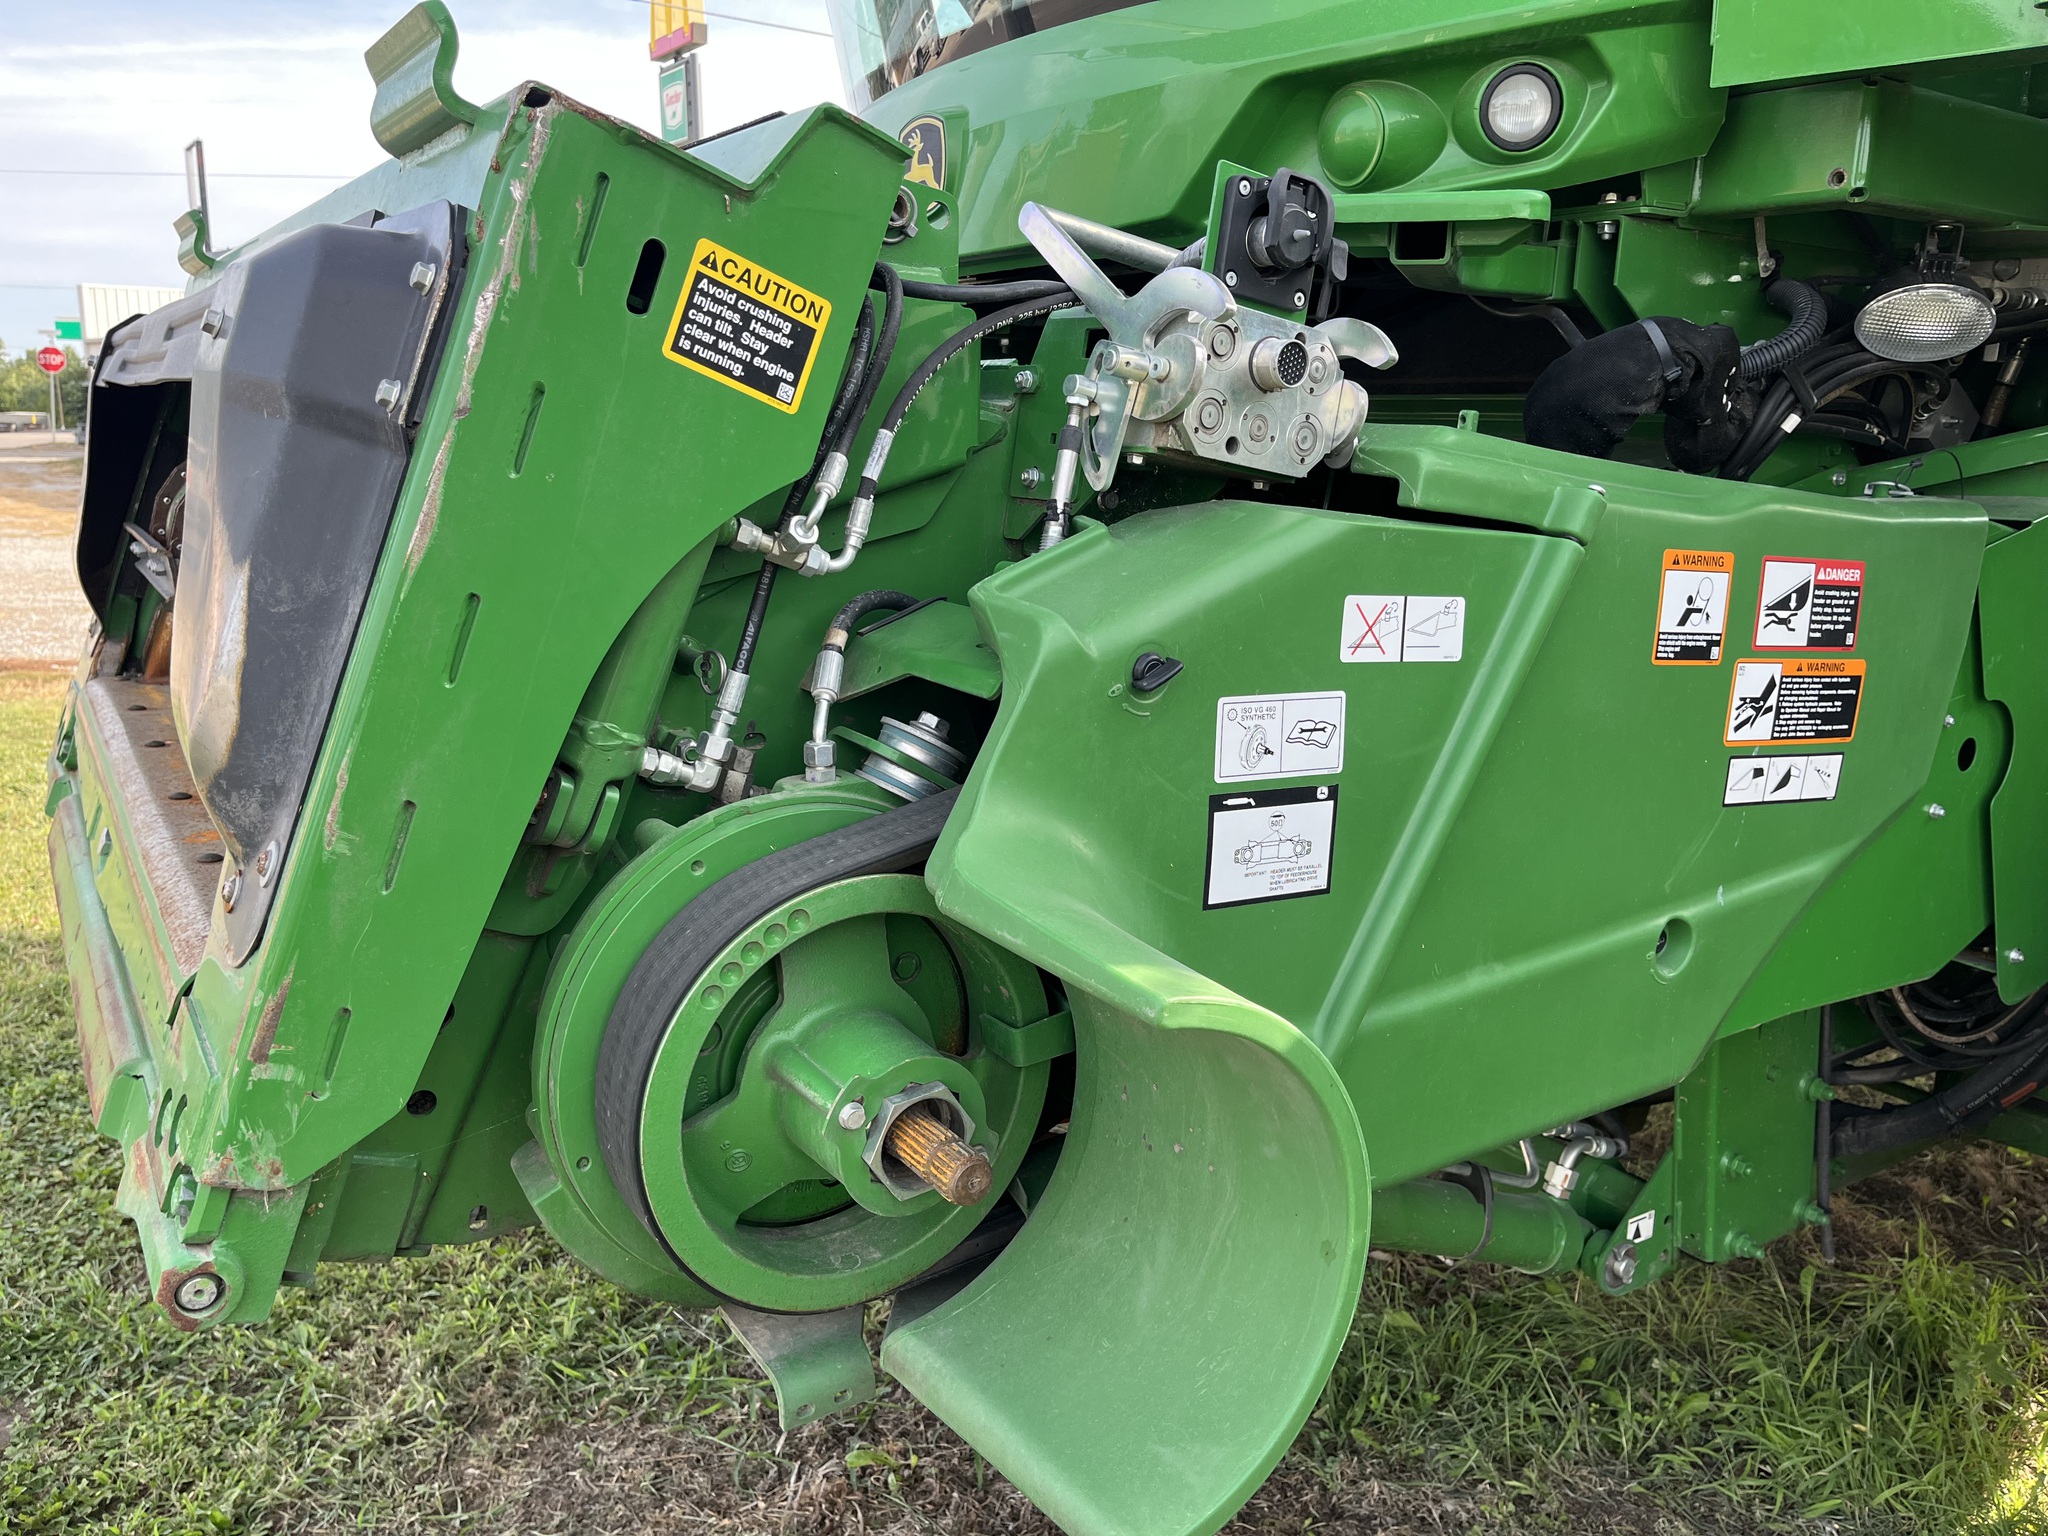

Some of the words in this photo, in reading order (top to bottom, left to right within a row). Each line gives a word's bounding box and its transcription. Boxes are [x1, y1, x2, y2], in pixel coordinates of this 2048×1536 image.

[721, 258, 825, 323] CAUTION
[692, 291, 743, 326] injuries.
[749, 319, 794, 349] Header
[697, 278, 737, 305] Avoid
[737, 299, 792, 335] crushing
[688, 308, 713, 327] can
[714, 318, 734, 338] tilt.
[740, 332, 769, 355] Stay
[38, 354, 65, 367] STOP
[678, 335, 692, 350] is
[693, 344, 745, 377] running.
[683, 323, 716, 344] clear
[718, 339, 751, 362] when
[753, 357, 795, 382] engine
[1682, 554, 1725, 568] WARNING
[1825, 568, 1861, 582] DANGER
[1806, 662, 1846, 672] WARNING
[1240, 713, 1277, 721] SYNTHETIC
[1265, 705, 1277, 713] 460
